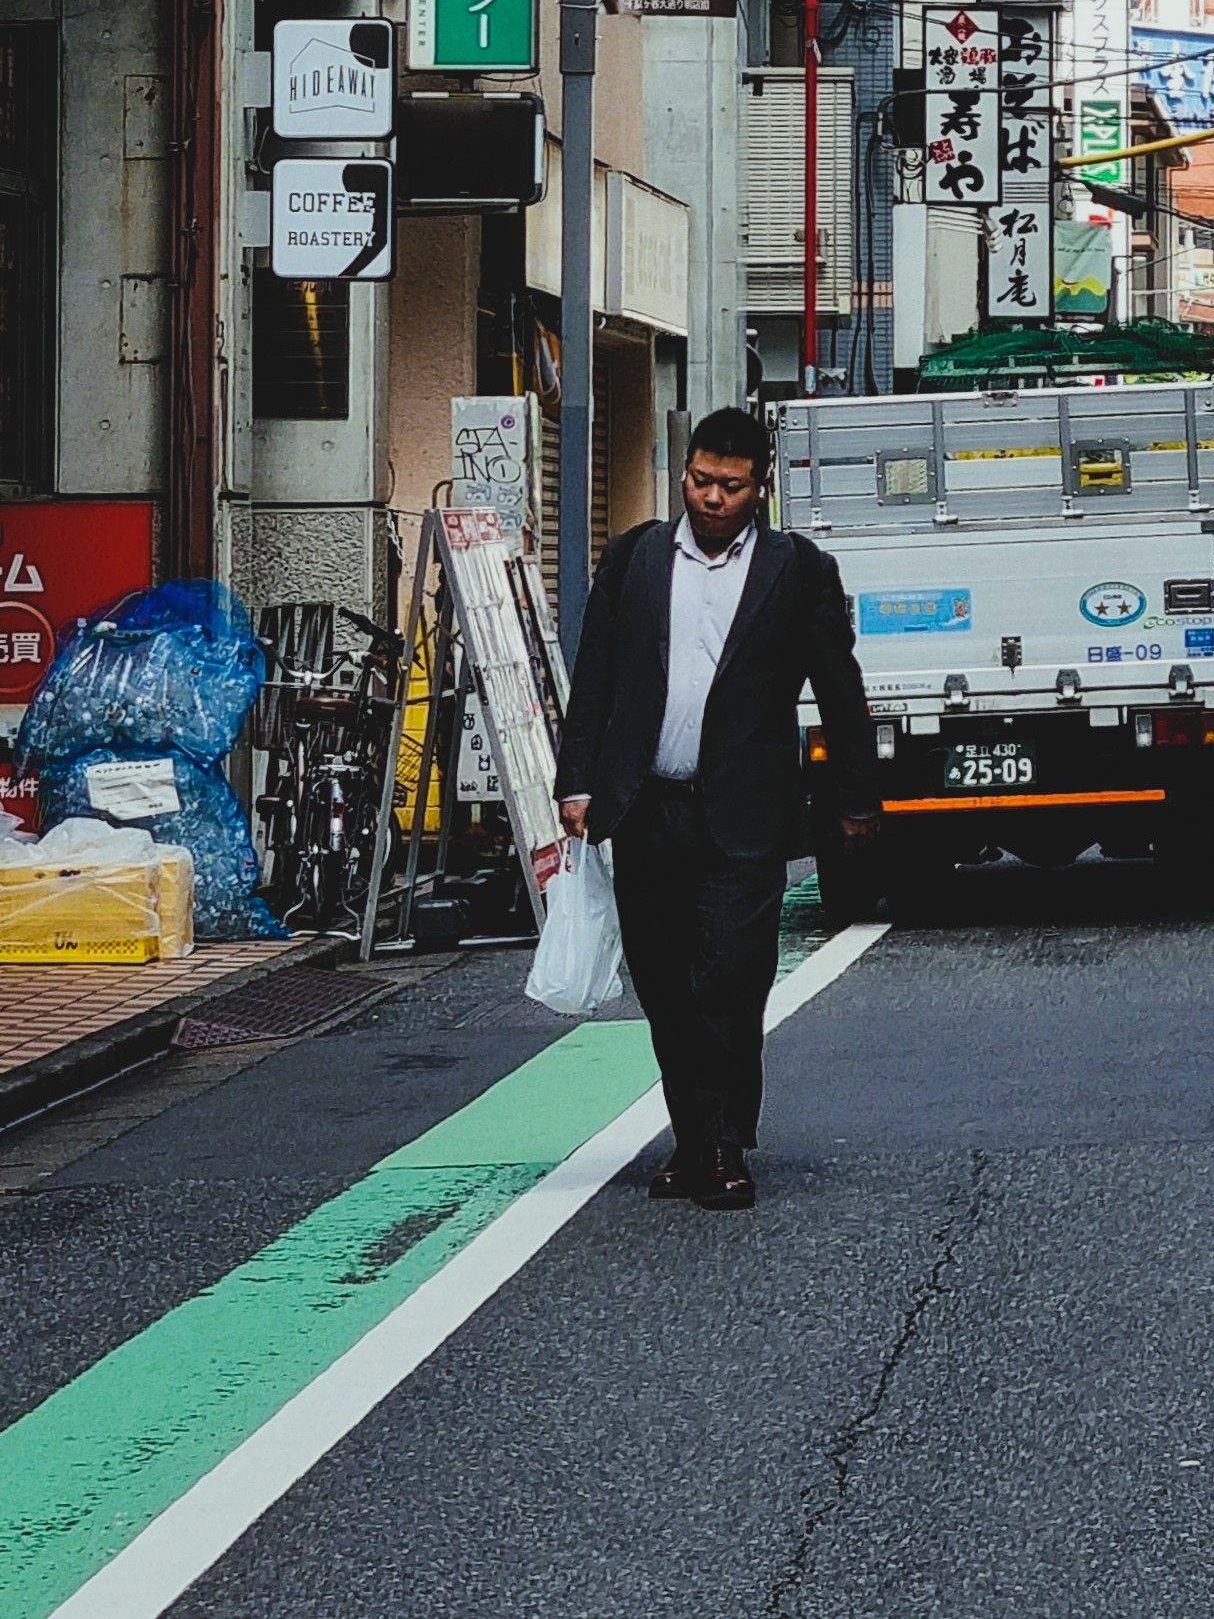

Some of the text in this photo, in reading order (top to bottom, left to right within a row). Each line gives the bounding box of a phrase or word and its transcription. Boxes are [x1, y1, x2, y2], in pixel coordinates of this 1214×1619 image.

[289, 65, 376, 102] HIDEAWAY
[938, 85, 985, 200] 寿や
[288, 192, 376, 214] COFFEE
[287, 231, 377, 247] ROASTERY
[992, 743, 1017, 757] 430
[962, 757, 1034, 785] 25-09
